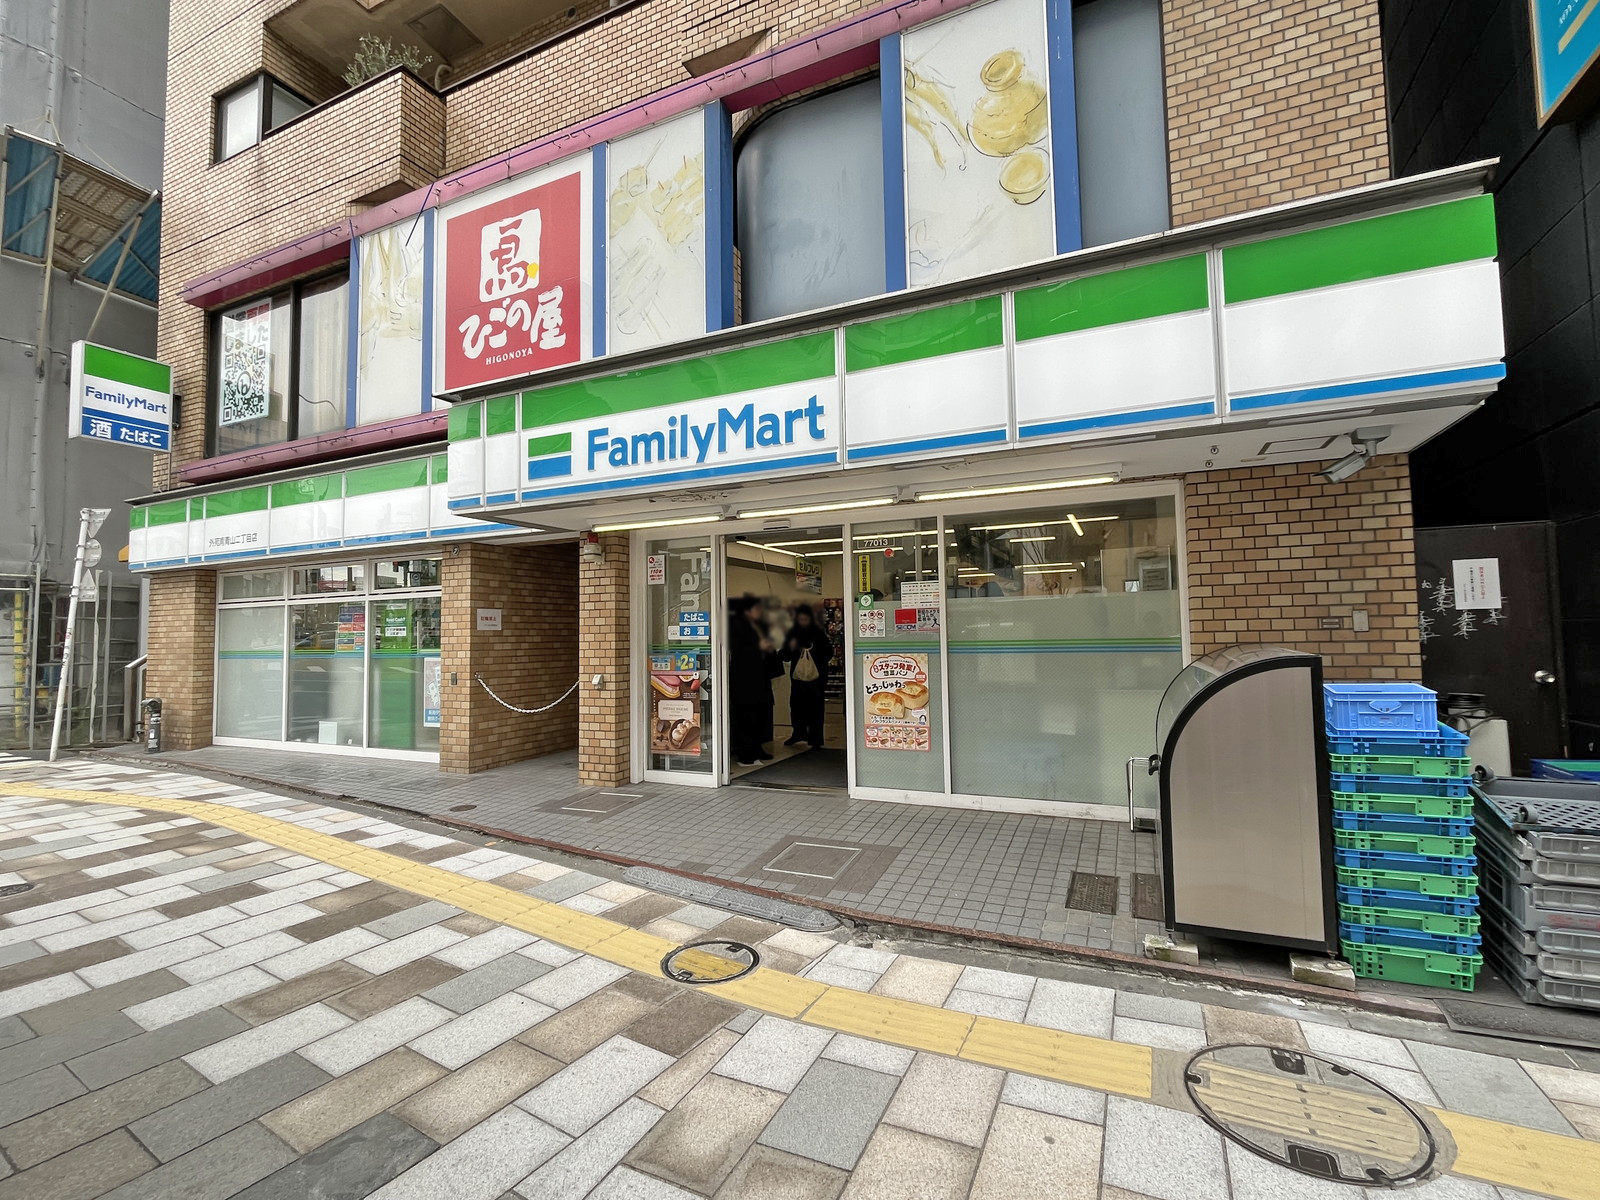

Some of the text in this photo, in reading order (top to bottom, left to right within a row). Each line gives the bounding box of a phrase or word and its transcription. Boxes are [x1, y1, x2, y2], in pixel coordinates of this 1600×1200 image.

[458, 285, 567, 360] ひごの屋
[485, 347, 533, 365] HIGONOYA
[85, 385, 167, 414] FamilyMart
[90, 418, 162, 446] 酒 たばこ
[587, 394, 825, 472] FamilyMart
[863, 538, 888, 547] 77013
[683, 613, 705, 622] たばこ
